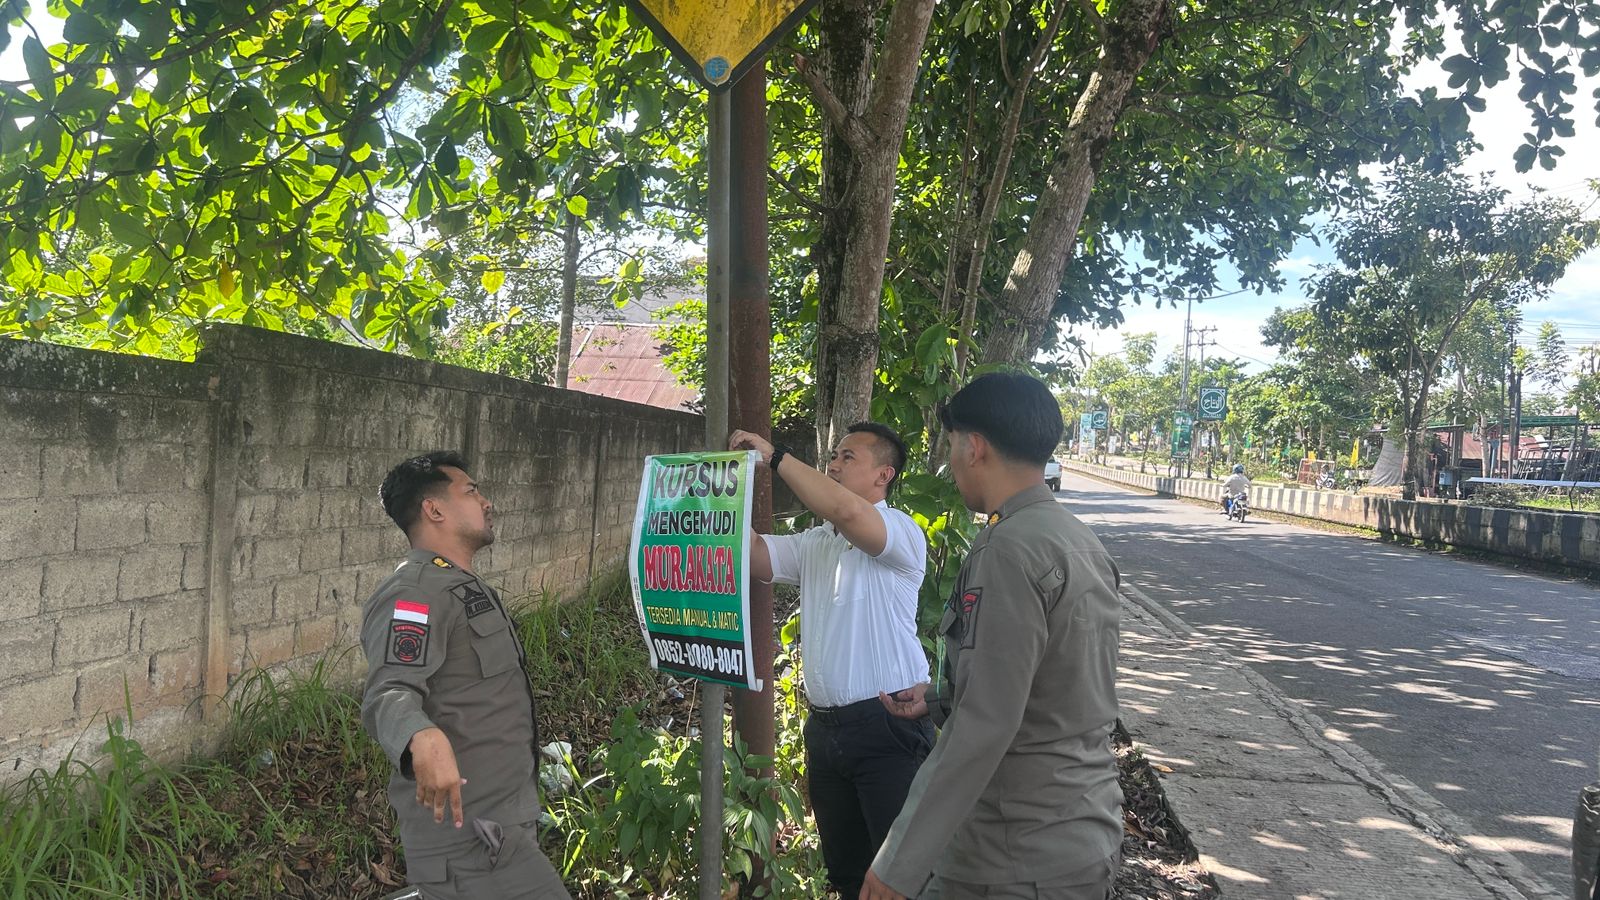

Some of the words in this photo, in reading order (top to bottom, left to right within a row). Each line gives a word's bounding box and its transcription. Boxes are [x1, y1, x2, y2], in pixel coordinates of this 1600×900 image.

[653, 460, 740, 498] KURSUS
[647, 510, 737, 536] MENGEMUDI
[644, 544, 736, 594] MURAKATA
[646, 606, 681, 625] TERSEDIA
[683, 608, 711, 628] MANUAL
[712, 611, 717, 628] &
[718, 611, 739, 631] MATIC
[654, 638, 743, 676] 0852-8080-8047
